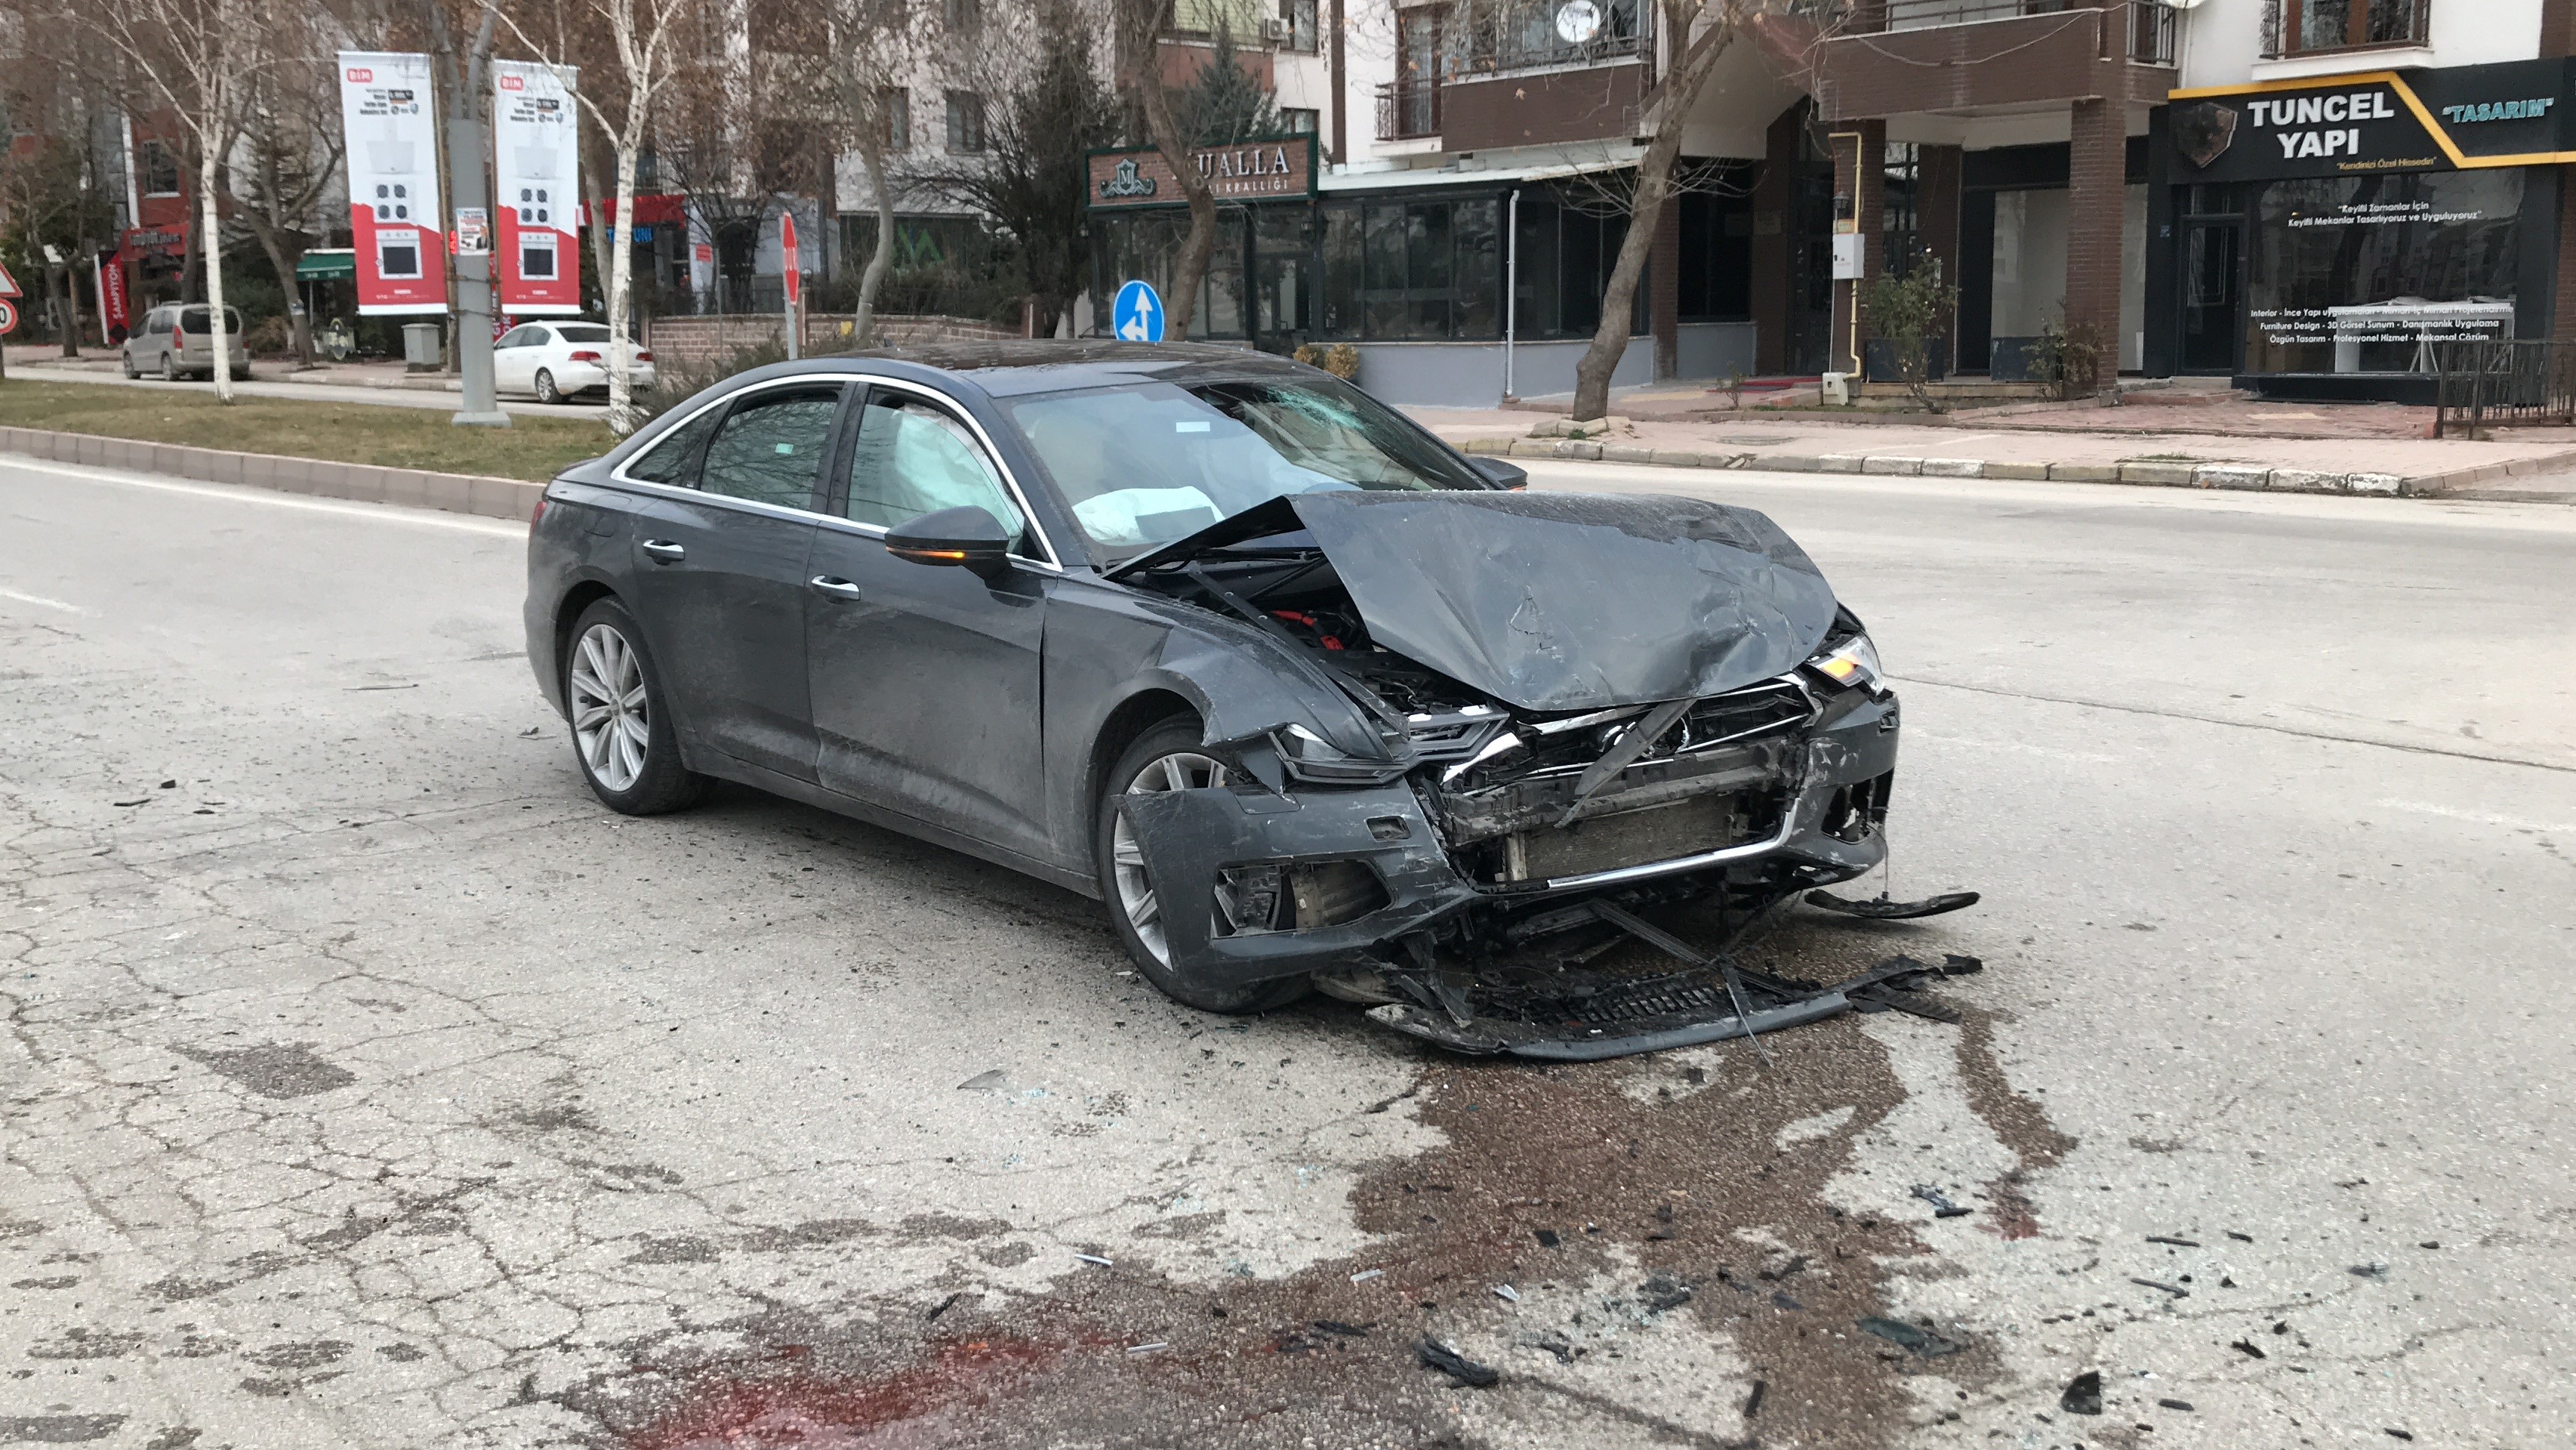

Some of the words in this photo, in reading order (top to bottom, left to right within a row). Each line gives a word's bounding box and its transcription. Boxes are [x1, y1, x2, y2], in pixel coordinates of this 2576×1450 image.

[2248, 91, 2395, 127] TUNCEL
[2276, 128, 2359, 159] YAPI
[1172, 147, 1290, 180] UALLA
[1121, 170, 1132, 185] M
[1225, 177, 1288, 193] KRALLIĞI
[2369, 202, 2411, 212] Zamanlar
[2314, 214, 2355, 226] Mekanlar
[0, 307, 7, 324] 0
[2251, 308, 2278, 317] Interior
[2284, 307, 2301, 317] İnce
[2303, 308, 2321, 318] Yapı
[2260, 322, 2292, 331] Furniture
[2294, 321, 2320, 332] Design
[2327, 321, 2337, 329] 3D
[2340, 320, 2366, 329] Görsel
[2368, 319, 2395, 329] Sunum
[2454, 319, 2500, 329] Uygulama
[2269, 334, 2294, 345] Özgün
[2296, 335, 2326, 344] Tasarım
[2333, 334, 2379, 344] Profesyonel
[2380, 333, 2408, 342] Hizmet
[2416, 333, 2457, 341] Mekansal
